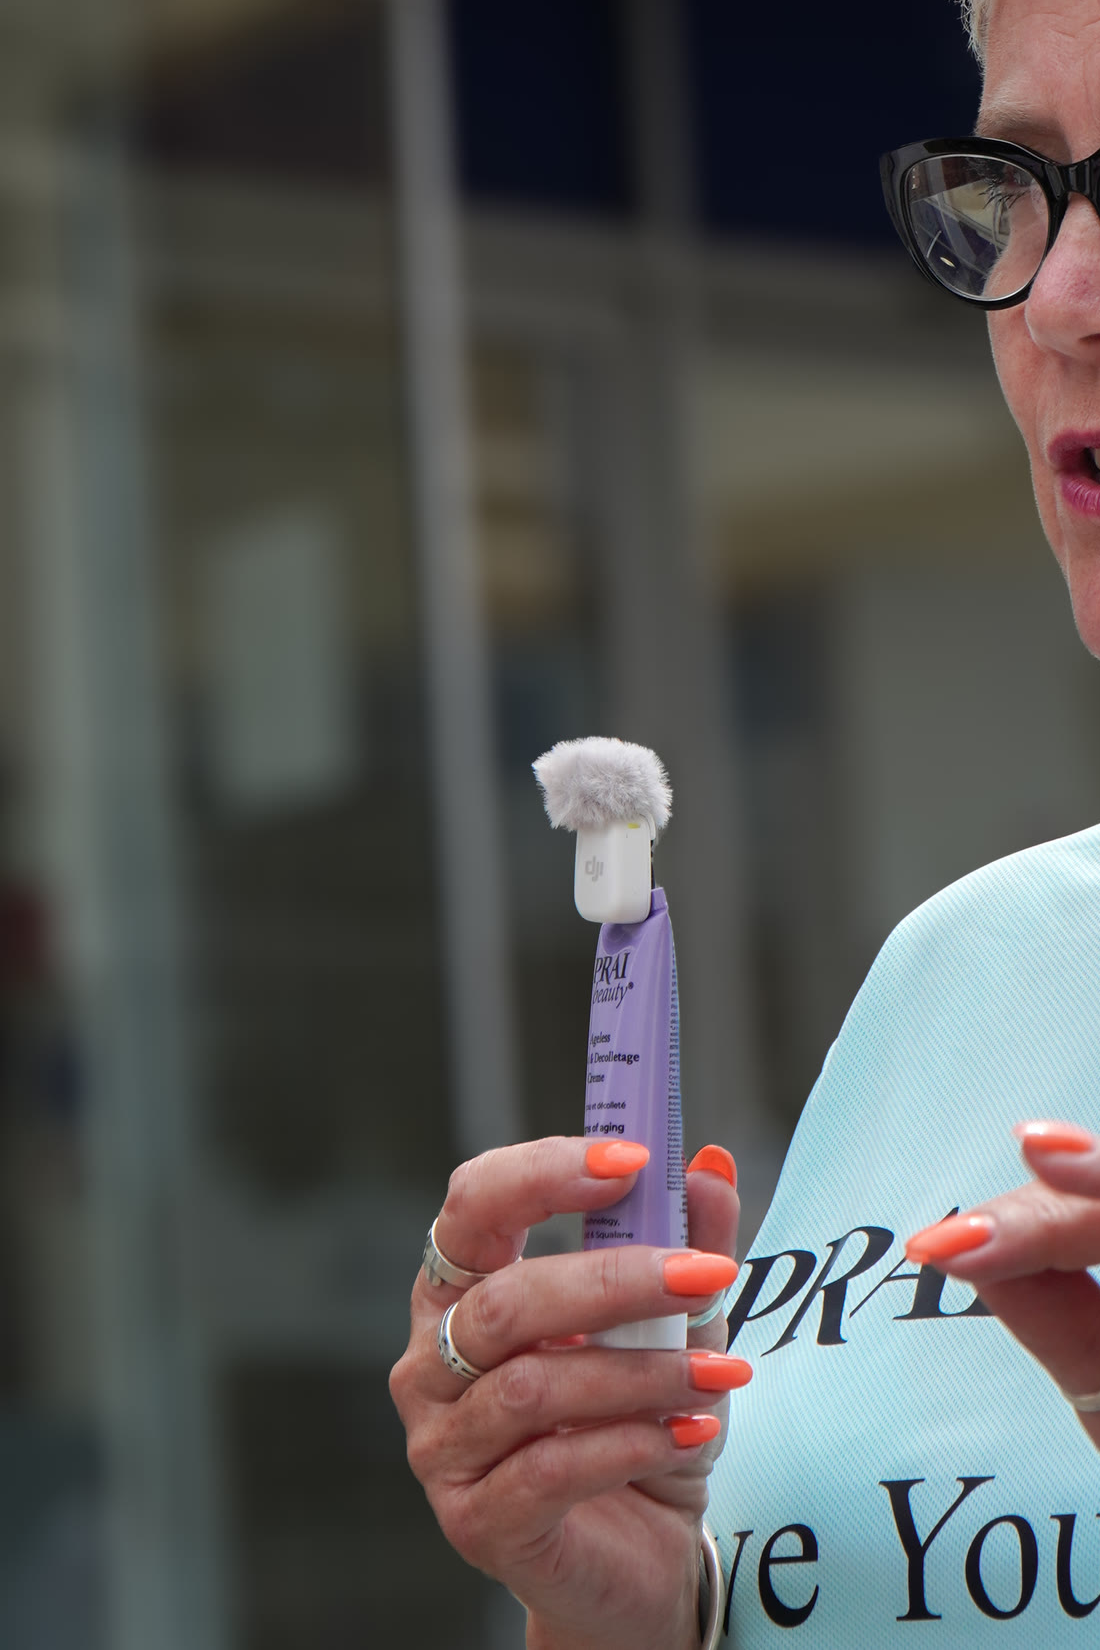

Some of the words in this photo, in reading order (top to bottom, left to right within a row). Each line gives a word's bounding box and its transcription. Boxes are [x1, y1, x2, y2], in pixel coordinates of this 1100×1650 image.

[593, 952, 631, 985] PRAI
[590, 1031, 611, 1048] Ageless
[594, 1051, 640, 1065] Decolletage
[600, 1121, 625, 1134] aging
[595, 1229, 634, 1240] Squalane
[726, 1206, 997, 1357] PRA
